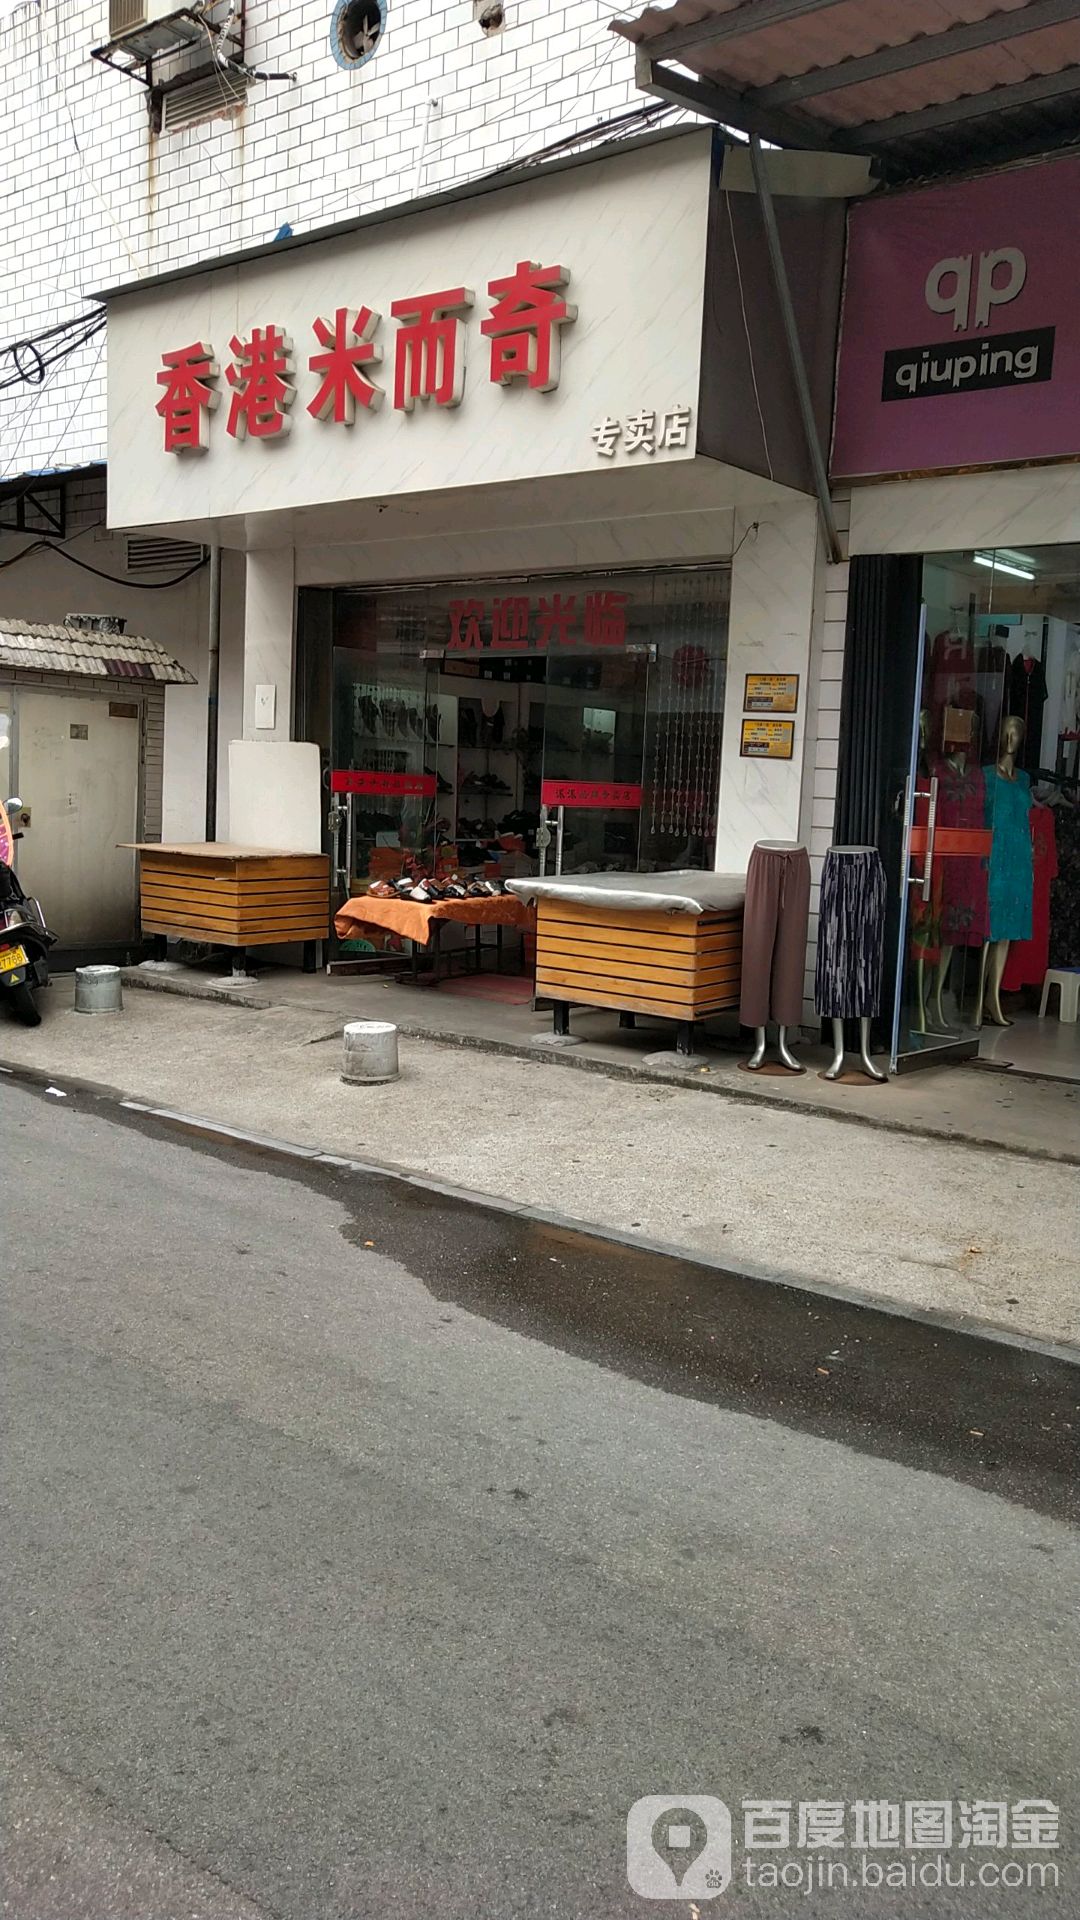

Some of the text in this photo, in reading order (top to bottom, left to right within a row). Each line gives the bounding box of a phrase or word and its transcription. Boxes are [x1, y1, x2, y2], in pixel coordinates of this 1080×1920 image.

[925, 247, 1027, 332] qp
[155, 260, 576, 453] 香港米而奇
[895, 342, 1039, 392] qiuping
[591, 404, 691, 456] 专卖店
[448, 592, 629, 649] 欢迎光临
